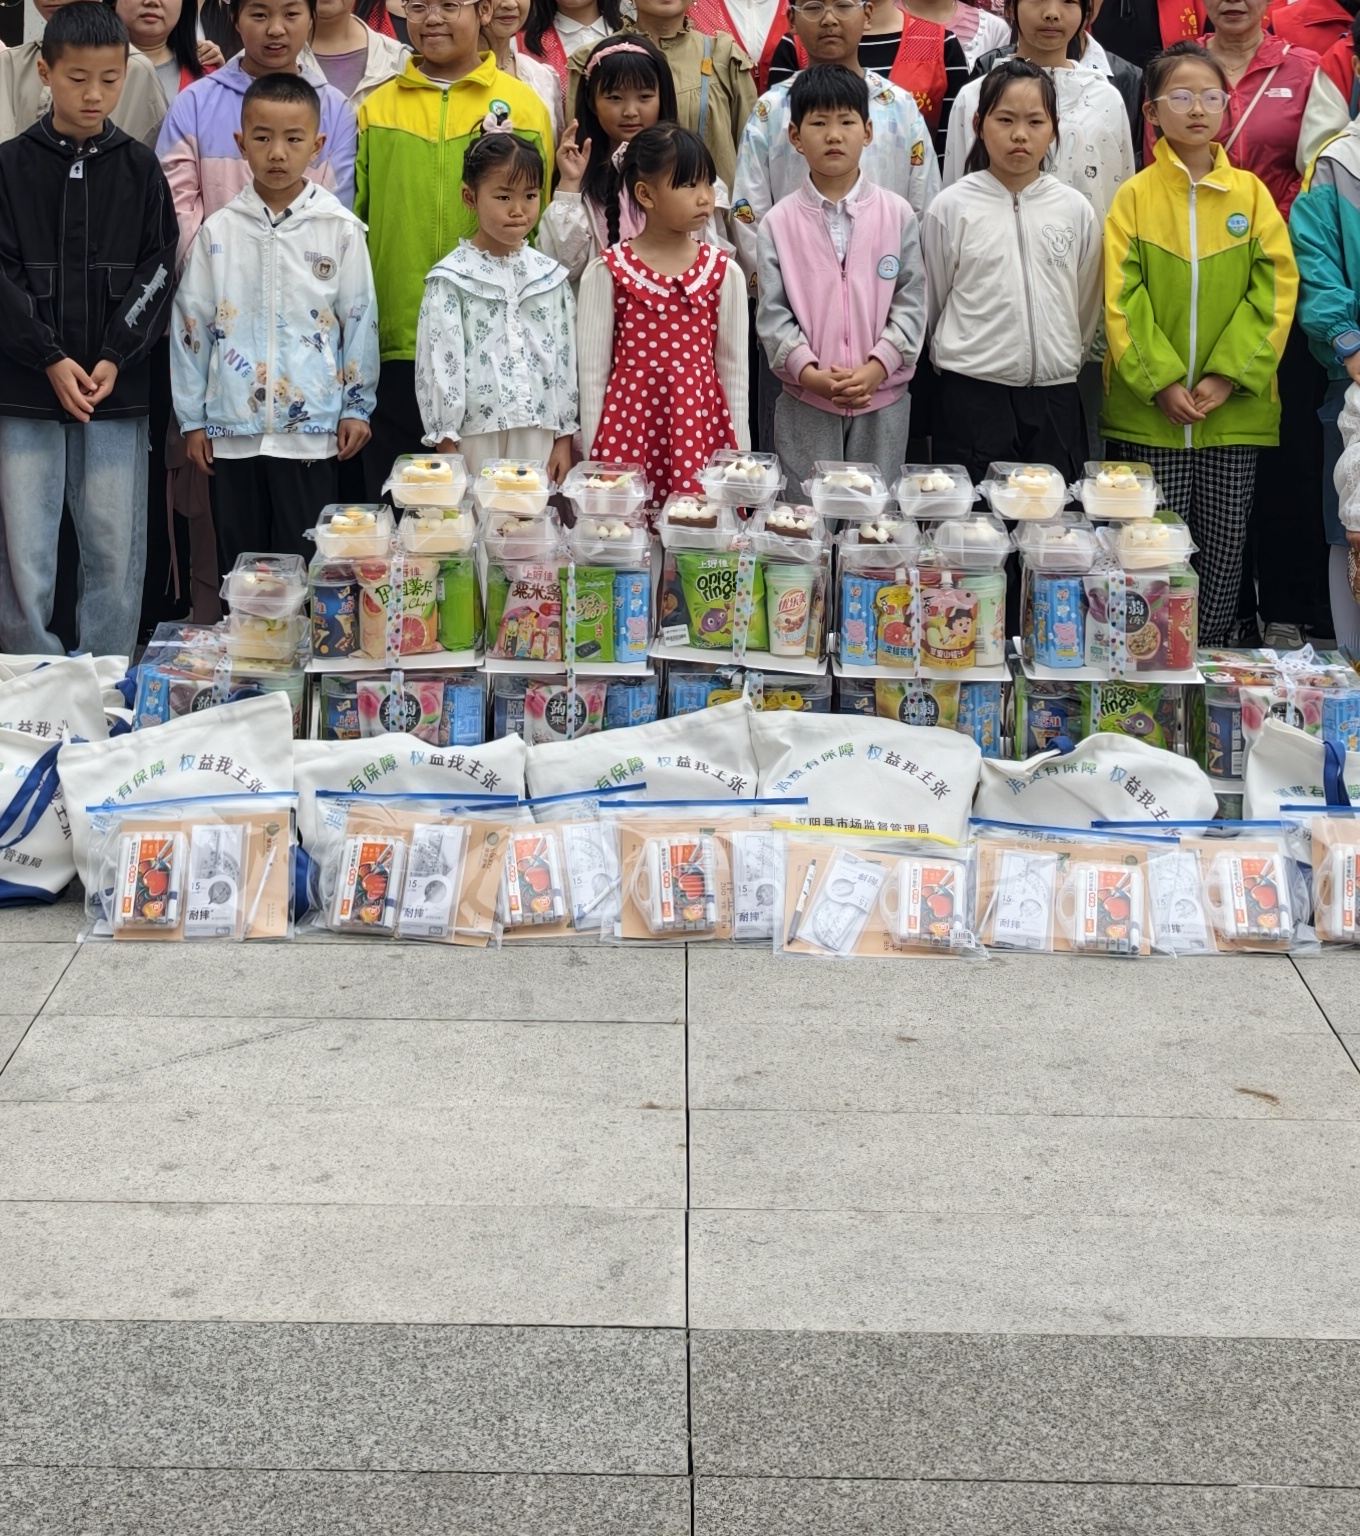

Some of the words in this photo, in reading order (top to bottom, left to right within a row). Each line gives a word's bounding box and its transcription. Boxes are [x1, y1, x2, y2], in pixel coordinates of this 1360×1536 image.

[866, 743, 951, 801] 权益我主张
